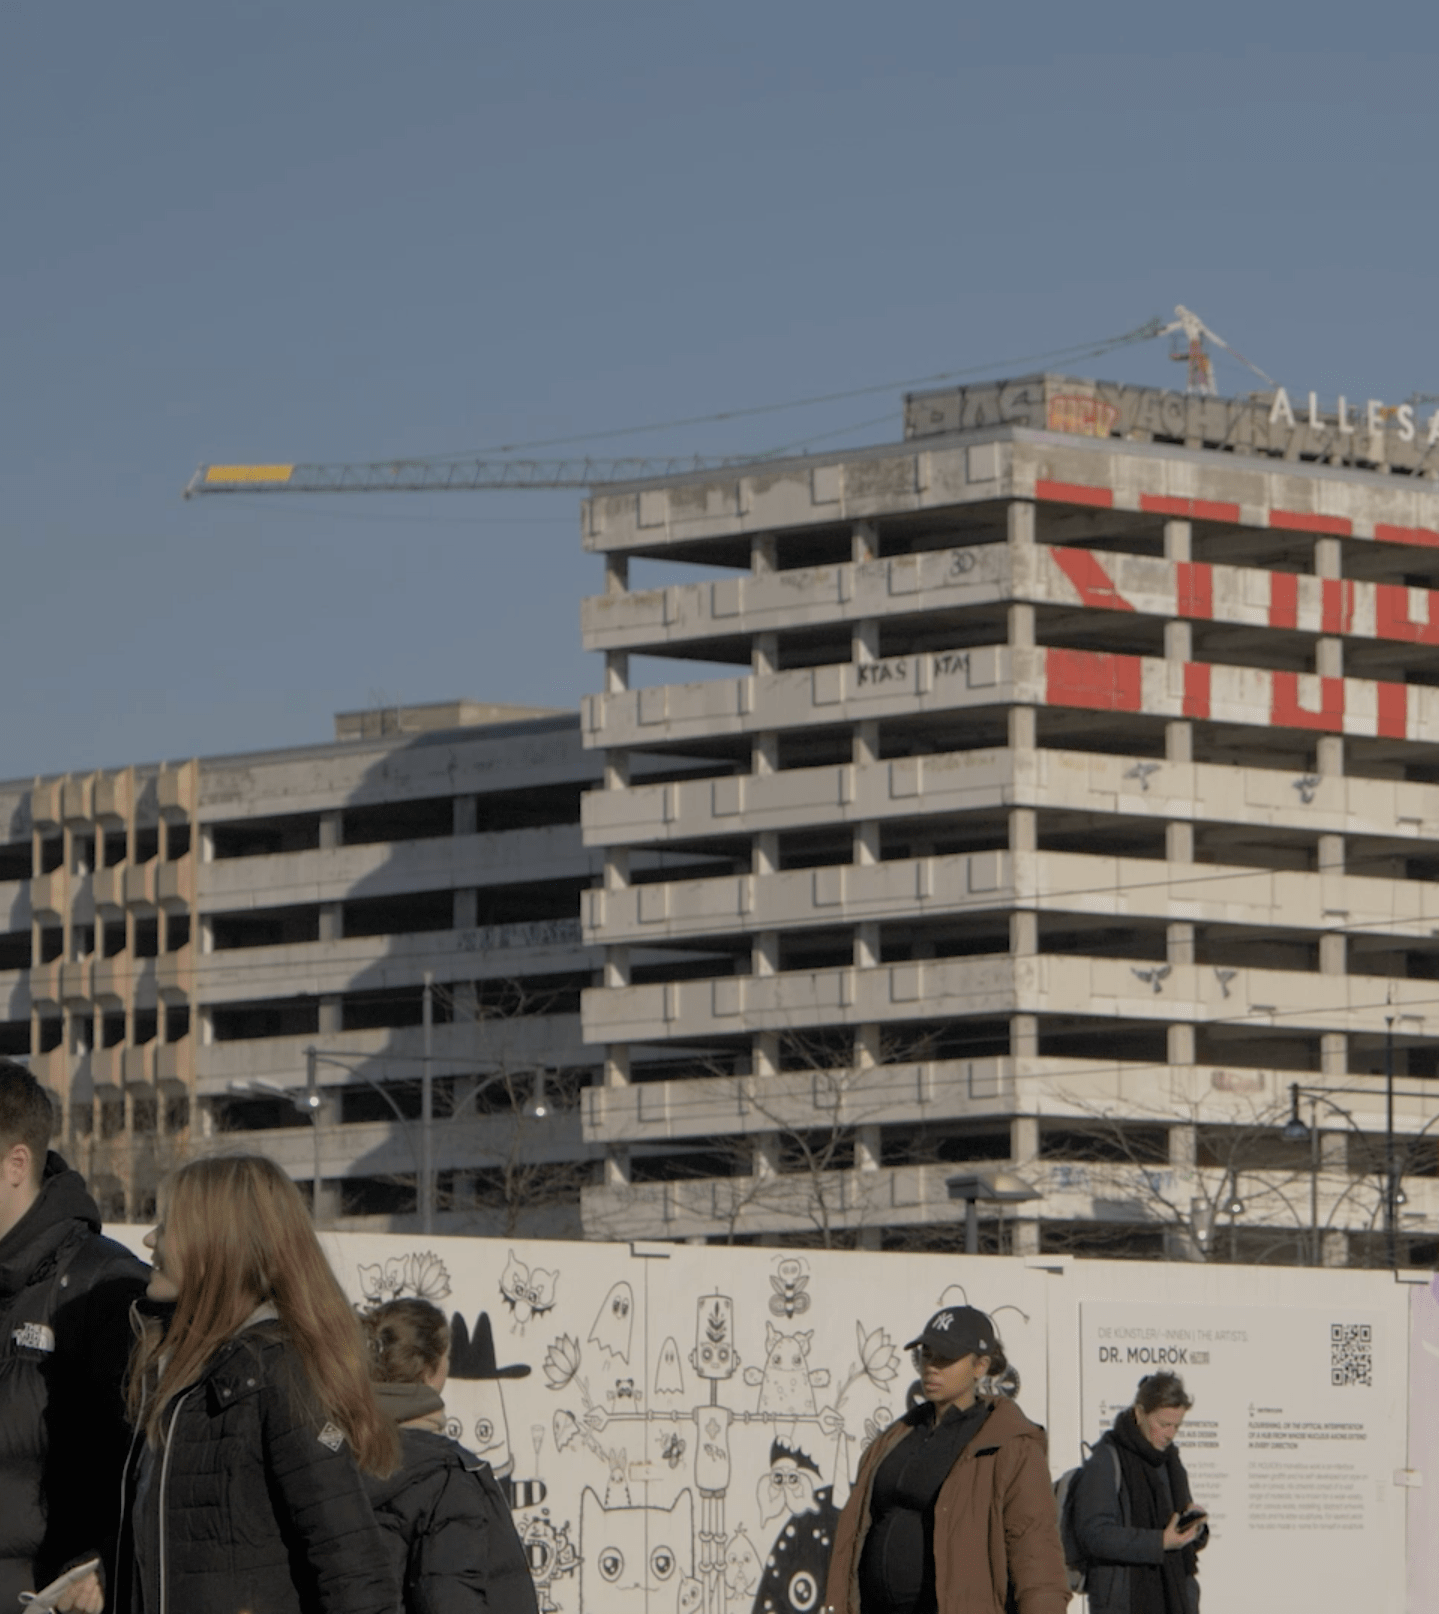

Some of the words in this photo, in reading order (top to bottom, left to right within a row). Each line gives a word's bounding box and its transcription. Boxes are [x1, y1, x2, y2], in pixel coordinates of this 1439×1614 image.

[1098, 1328, 1112, 1339] DIE
[1197, 1330, 1213, 1341] THE
[1098, 1346, 1123, 1363] DR.
[1127, 1345, 1188, 1364] MOLRÖK
